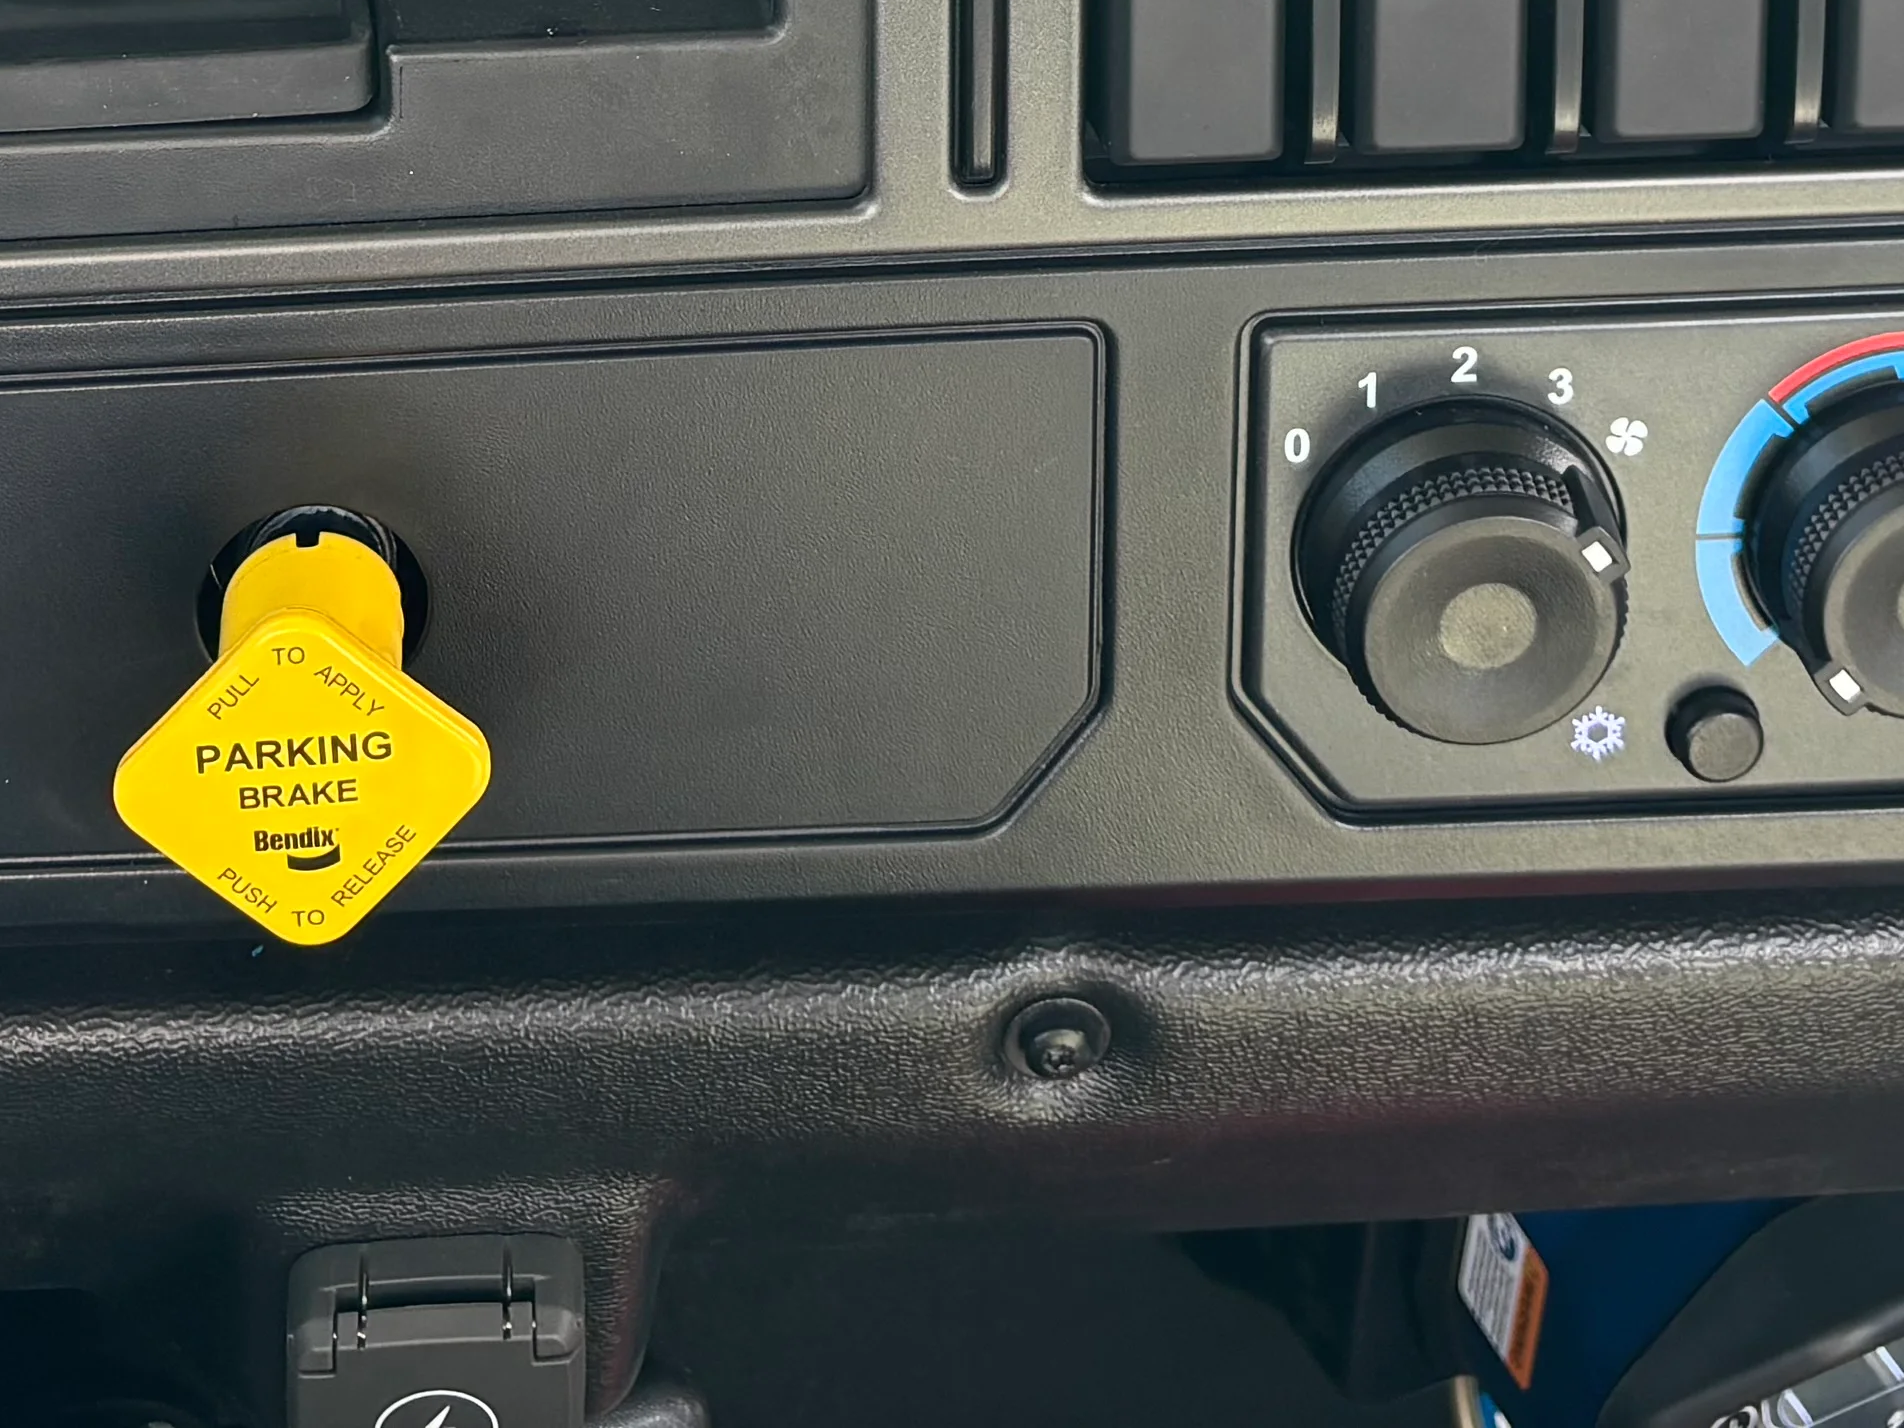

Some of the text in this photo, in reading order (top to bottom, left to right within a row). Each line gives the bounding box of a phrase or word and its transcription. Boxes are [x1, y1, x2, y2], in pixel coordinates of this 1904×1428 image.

[1450, 346, 1479, 383] 2
[1357, 371, 1377, 409] 1
[1547, 367, 1575, 406] 3
[1284, 428, 1311, 464] 0
[207, 646, 385, 720] PULL TO APPLY
[196, 731, 392, 775] PARKING
[239, 778, 359, 810] BRAKE
[253, 826, 335, 852] Bendix
[217, 825, 416, 928] PUSH TO RELEASE
